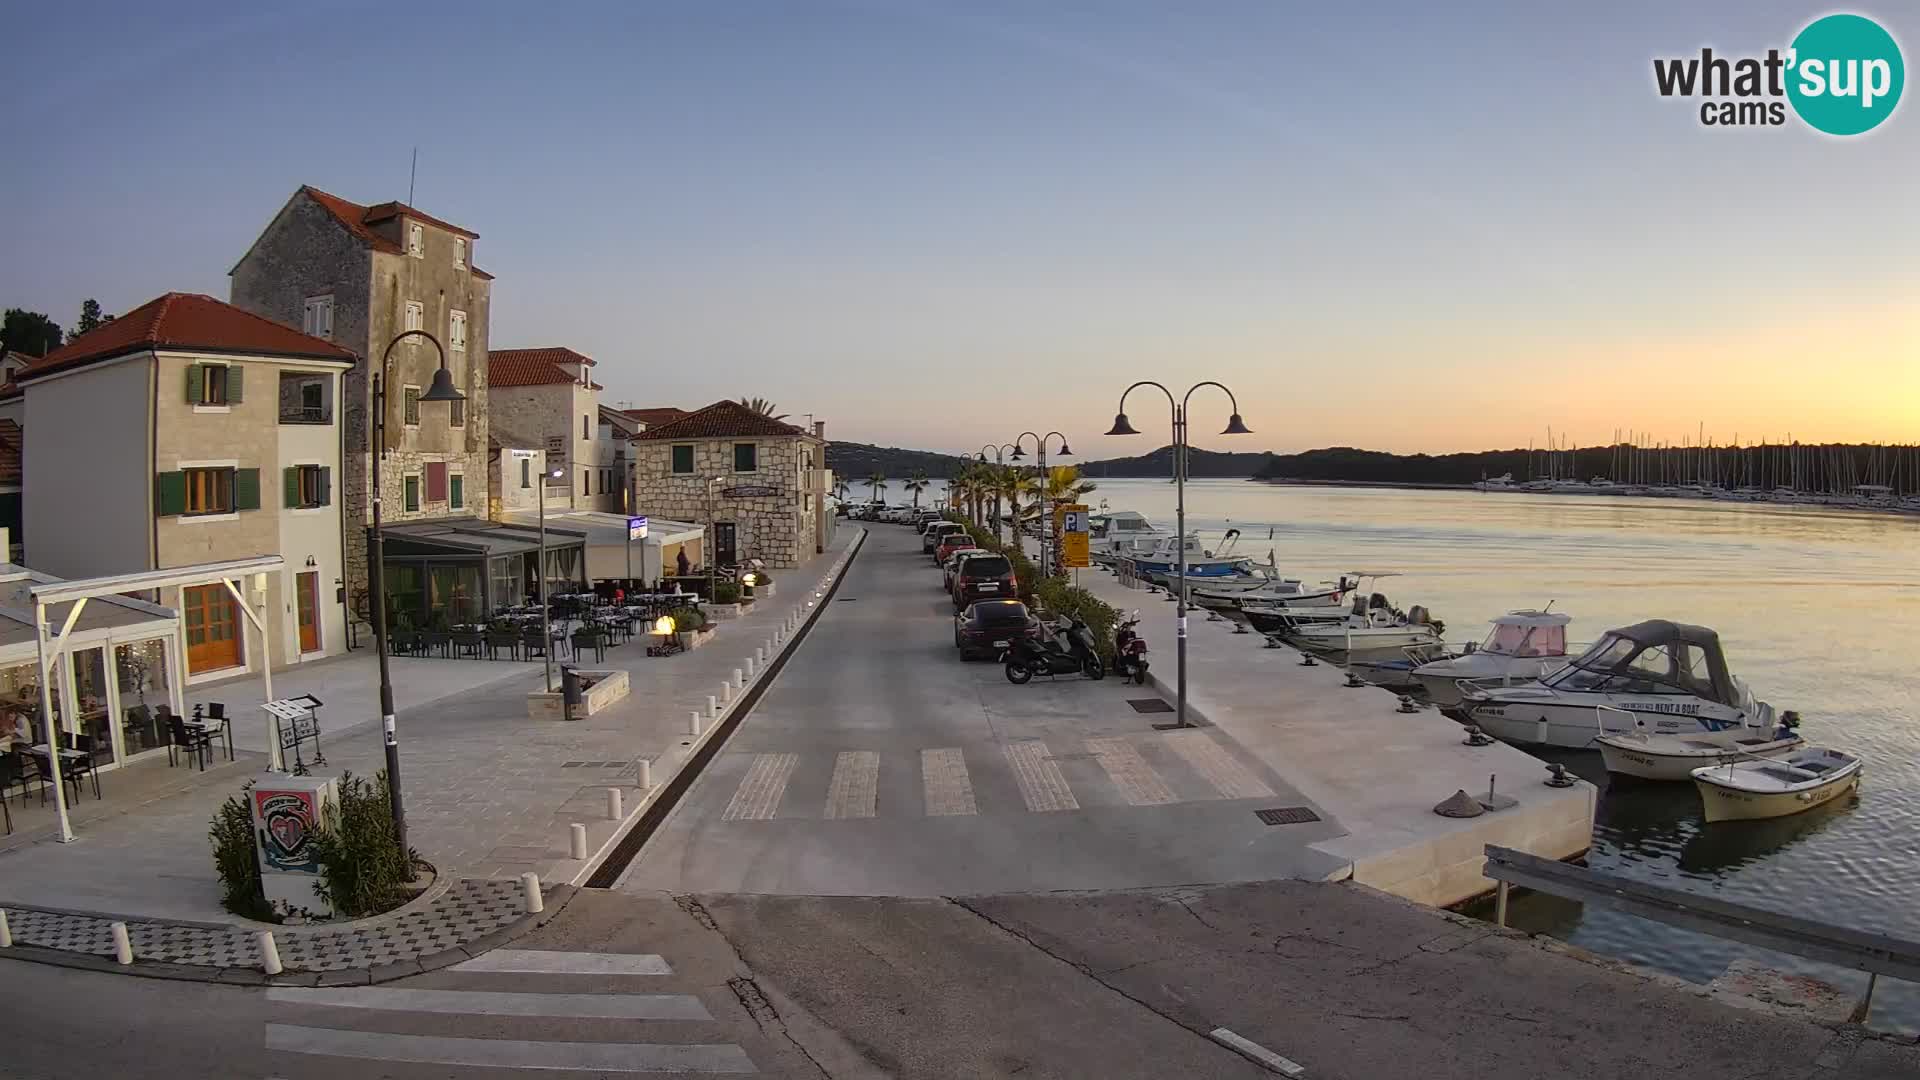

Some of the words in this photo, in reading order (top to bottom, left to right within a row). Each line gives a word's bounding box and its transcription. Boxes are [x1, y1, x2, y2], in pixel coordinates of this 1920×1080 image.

[1065, 513, 1076, 530] P
[1655, 703, 1675, 713] RENT
[1681, 703, 1701, 716] BOAT
